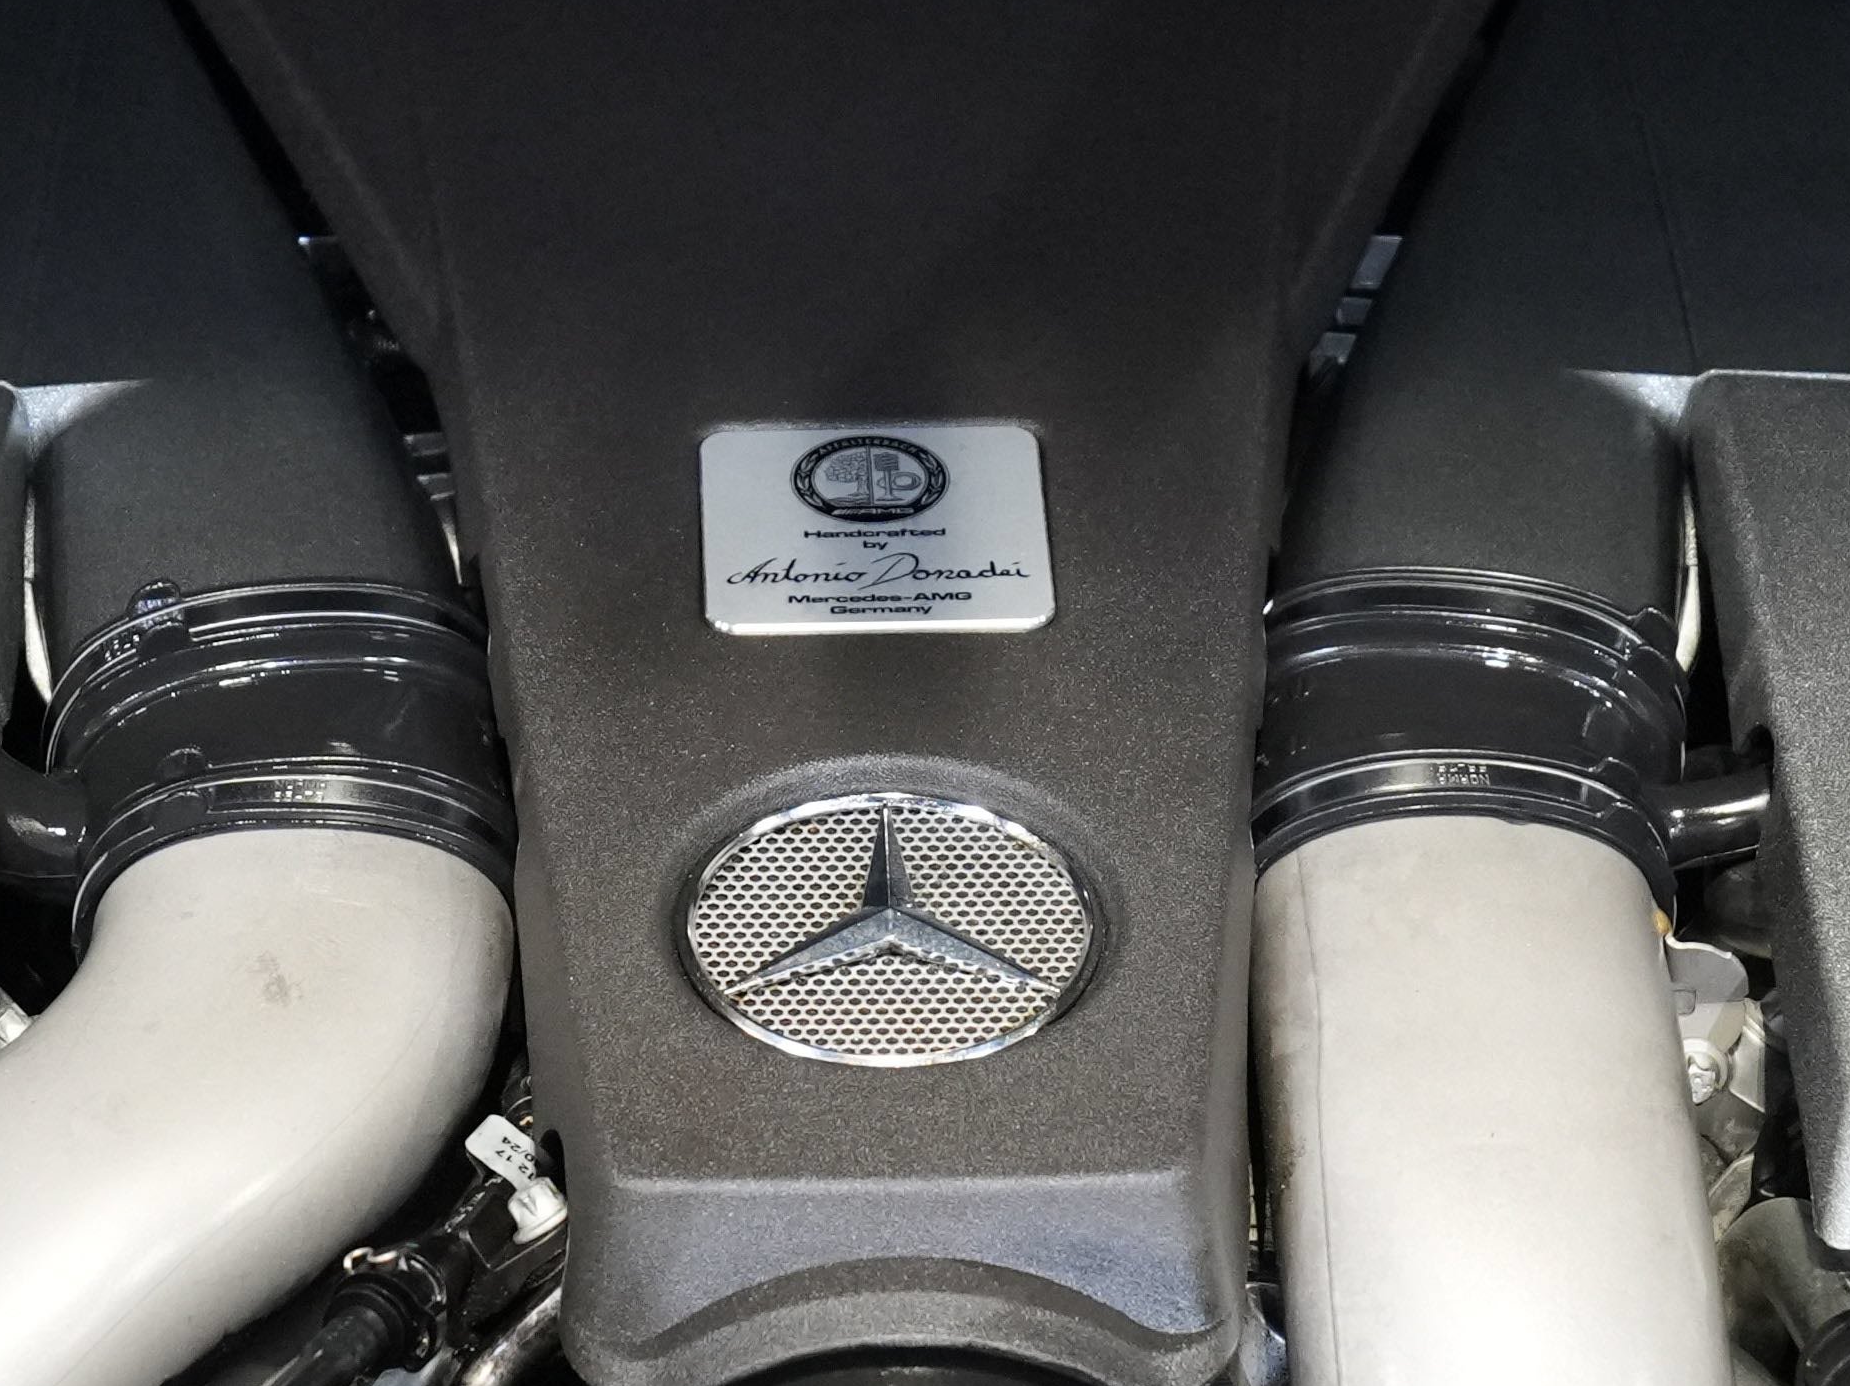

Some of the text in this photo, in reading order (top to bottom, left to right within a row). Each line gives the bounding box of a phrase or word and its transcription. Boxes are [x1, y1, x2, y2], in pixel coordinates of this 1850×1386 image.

[804, 528, 946, 539] Handcrafted
[863, 540, 888, 550] by
[726, 552, 1031, 591] Antonio Donadei
[788, 592, 972, 604] Mercedes-AMG
[830, 604, 932, 615] Germany
[495, 1149, 513, 1164] 17
